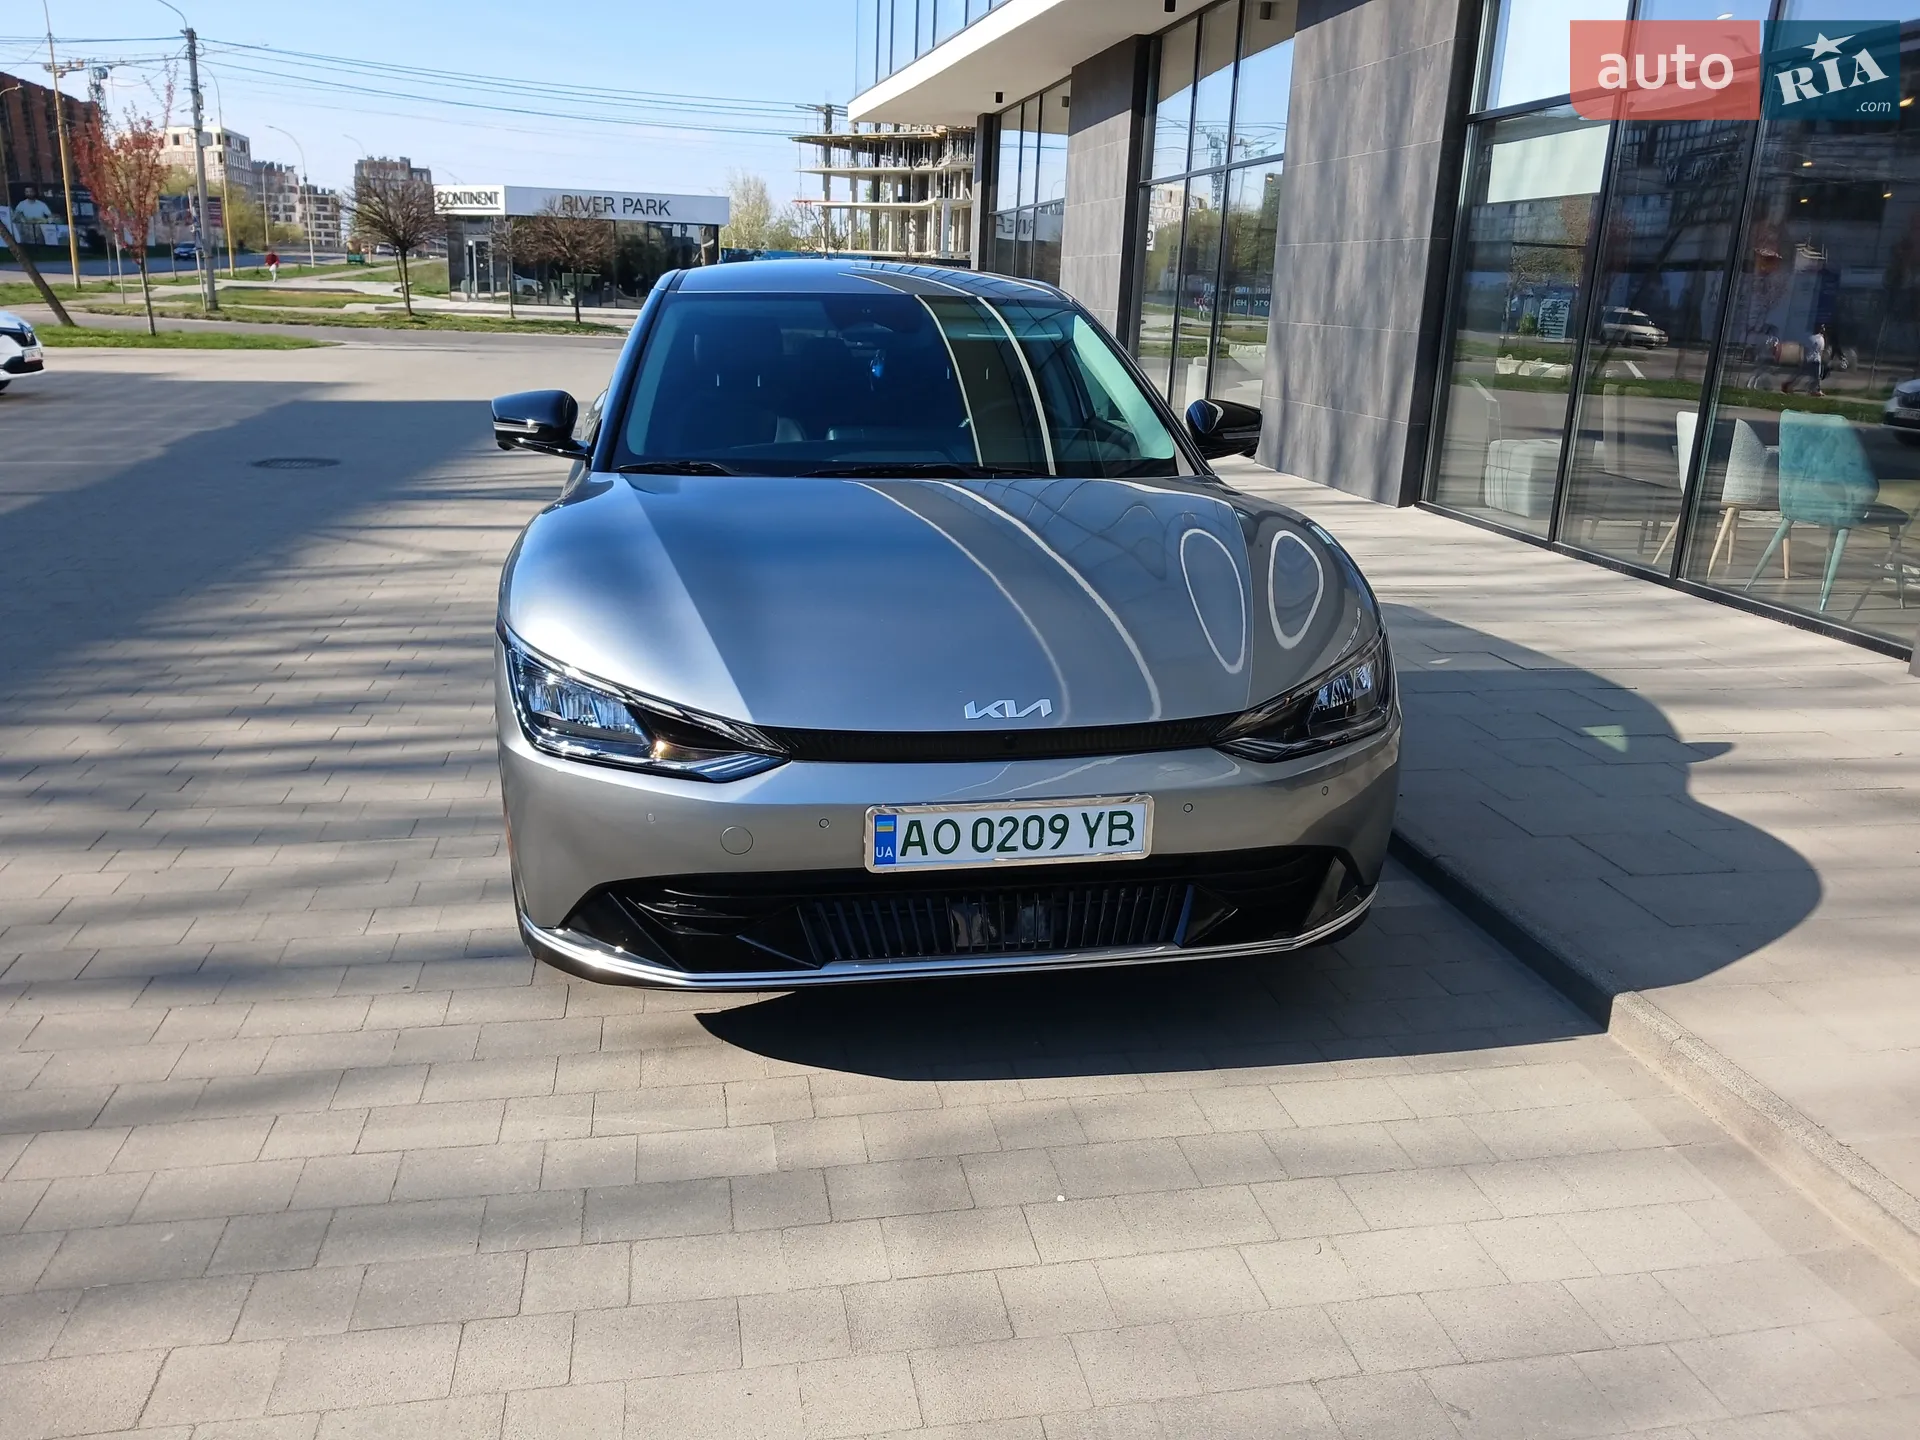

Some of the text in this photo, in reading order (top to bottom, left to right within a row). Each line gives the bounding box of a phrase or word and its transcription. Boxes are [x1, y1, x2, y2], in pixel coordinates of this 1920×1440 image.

[437, 190, 499, 206] CONTINENT
[562, 195, 671, 216] RIVER PARK
[900, 810, 1134, 857] AO 0209 YB
[875, 846, 893, 858] UA
